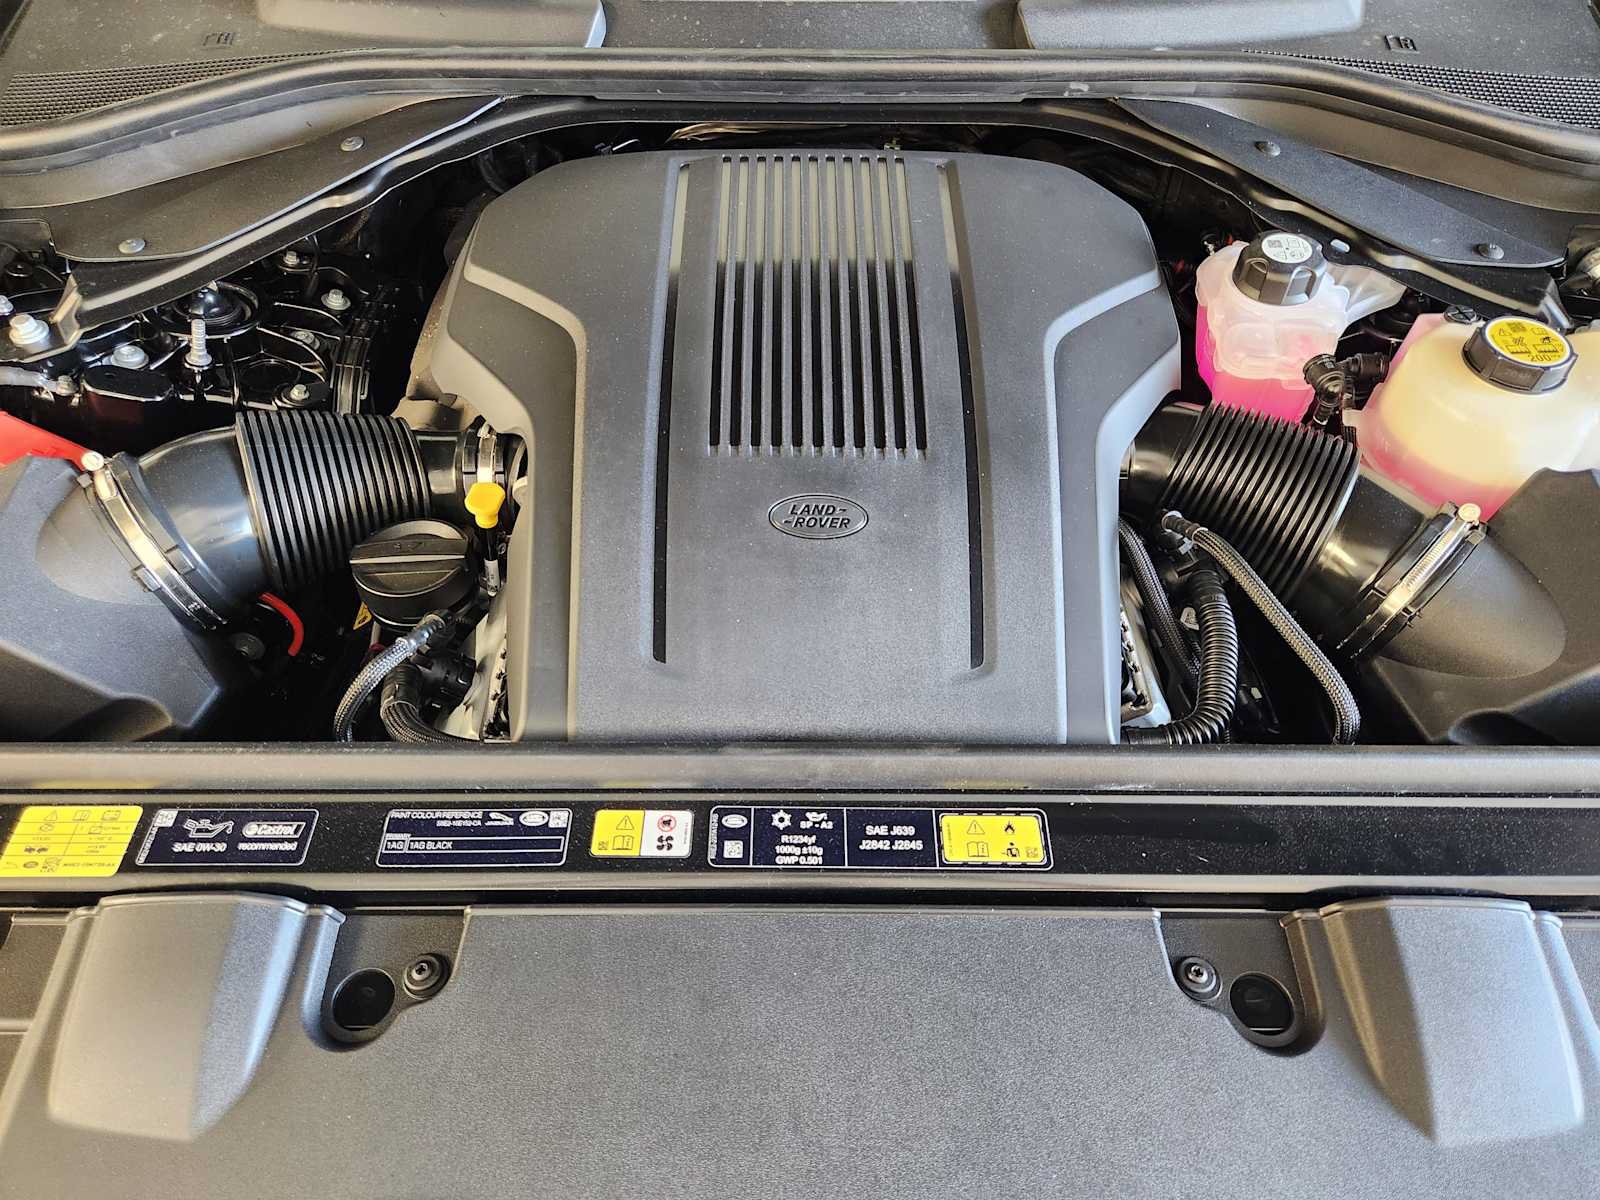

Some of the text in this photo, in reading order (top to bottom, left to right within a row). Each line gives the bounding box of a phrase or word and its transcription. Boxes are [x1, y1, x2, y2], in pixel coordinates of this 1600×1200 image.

[790, 503, 836, 516] LAND
[792, 516, 850, 529] ROVER
[411, 811, 442, 819] COLOUR
[442, 811, 483, 819] REFERENCE
[257, 824, 298, 835] Castrol
[866, 825, 916, 836] SAE J639
[780, 834, 817, 845] R1234yf
[859, 839, 923, 851] J2842 J2845
[171, 842, 195, 852] SAE
[237, 841, 298, 851] recommended
[386, 841, 404, 850] 1AG
[409, 841, 453, 850] 1AG BLACK
[775, 845, 801, 856] 1000g
[775, 855, 823, 865] GWP 0.501
